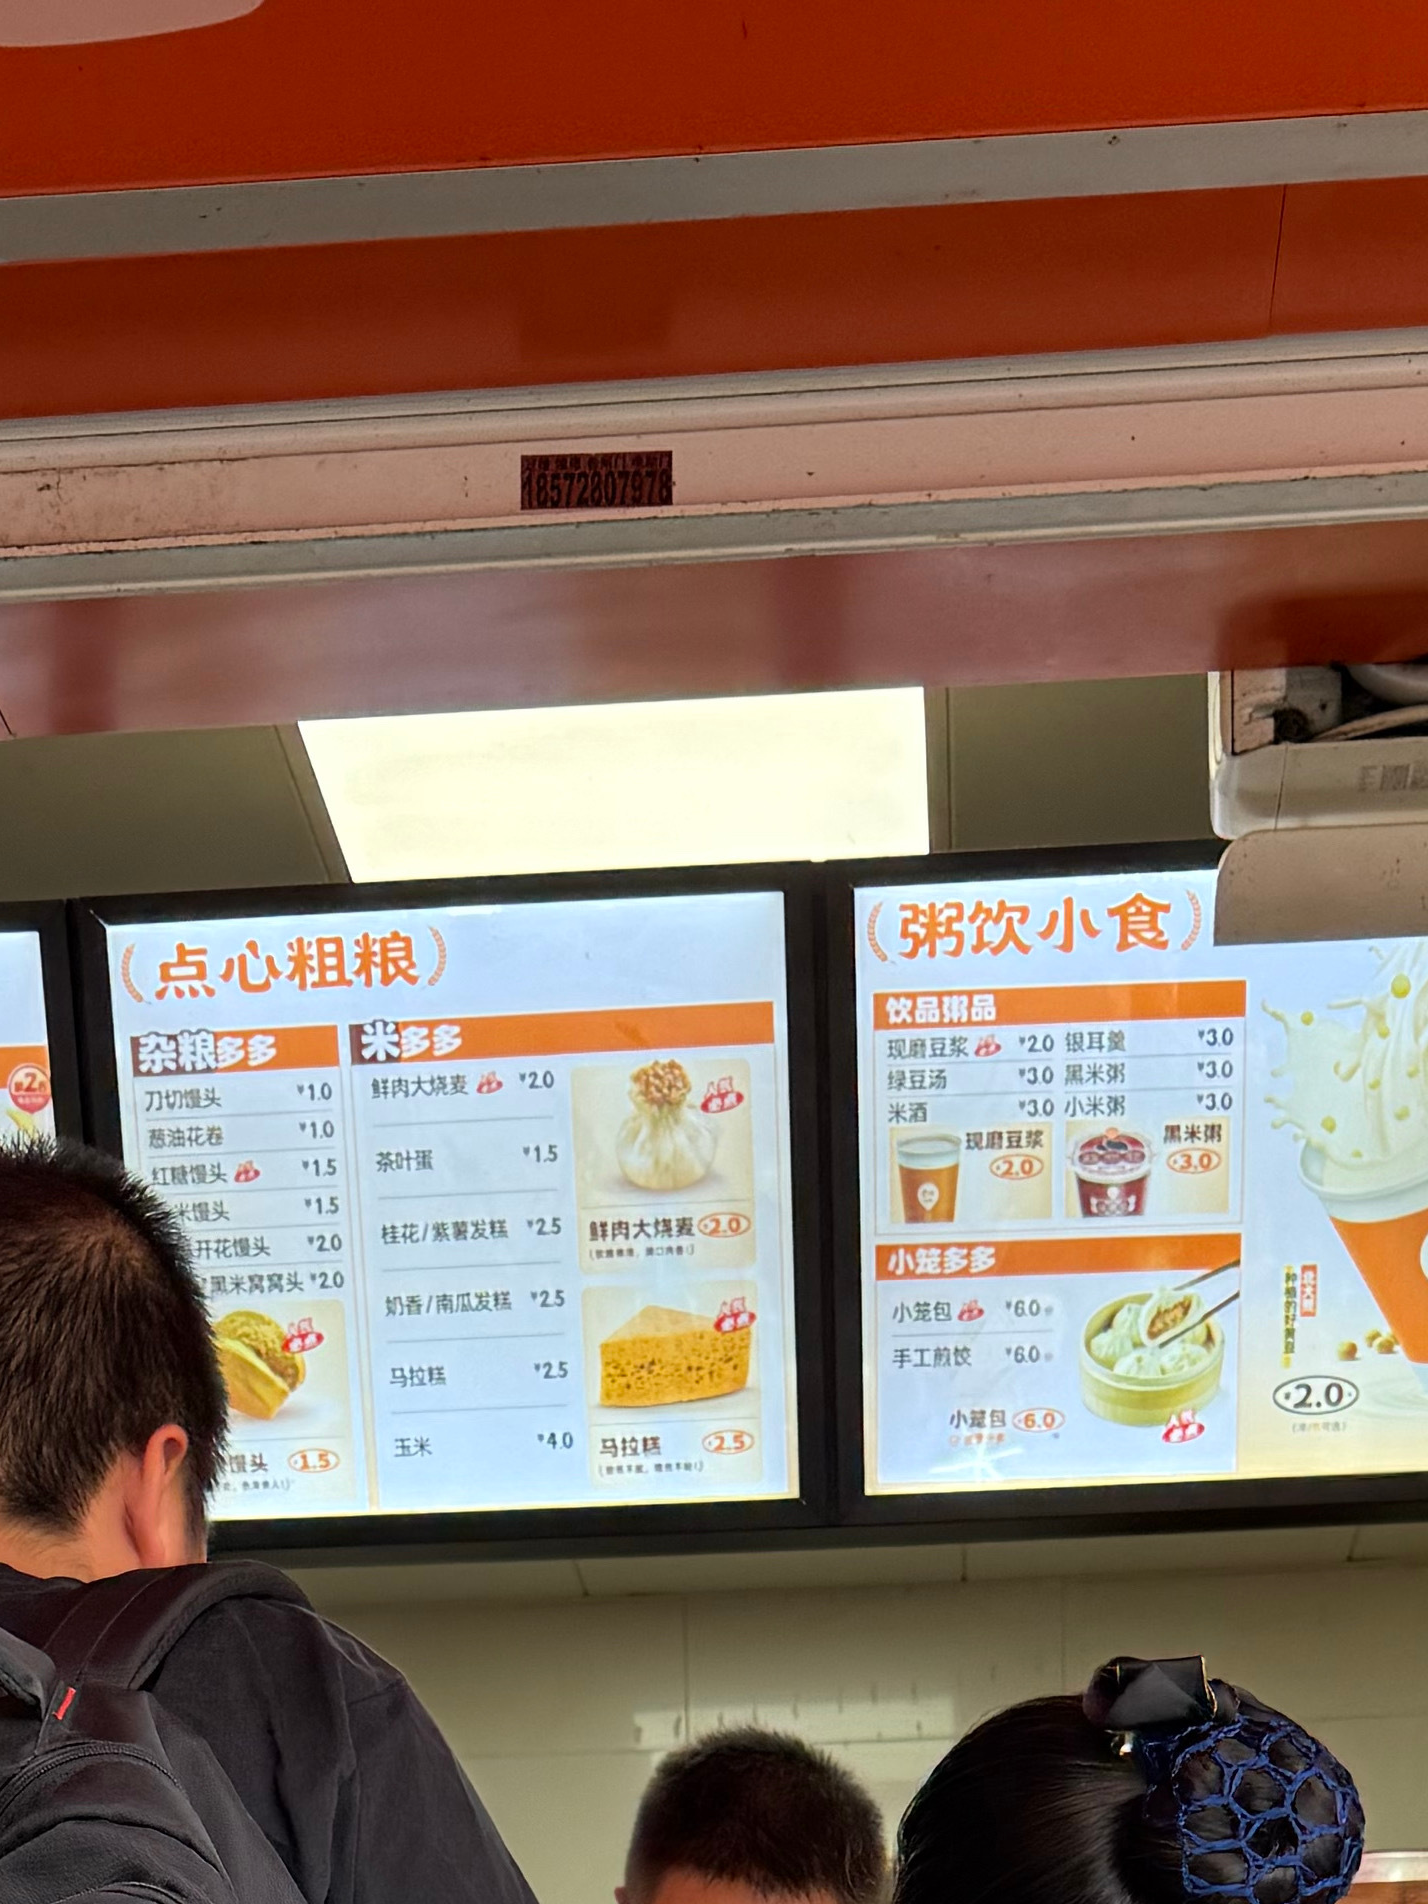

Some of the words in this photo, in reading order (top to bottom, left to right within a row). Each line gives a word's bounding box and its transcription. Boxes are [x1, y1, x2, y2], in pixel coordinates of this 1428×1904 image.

[898, 892, 1171, 959] 粥饮小食
[155, 930, 420, 1000] 点心粗粮
[886, 994, 996, 1024] 饮品粥品
[139, 1030, 277, 1073] 杂粮多多
[361, 1019, 462, 1062] 米多多
[887, 1036, 969, 1060] 现磨豆浆
[1065, 1063, 1127, 1085] 黑米粥
[888, 1102, 928, 1124] 米酒
[1065, 1095, 1127, 1117] 小米粥
[375, 1149, 433, 1173] 茶叶蛋
[173, 1200, 230, 1222] 米馒头
[887, 1247, 997, 1276] 小笼多多
[892, 1301, 951, 1323] 小笼包
[390, 1366, 446, 1388] 马拉糕
[394, 1435, 433, 1458] 玉米
